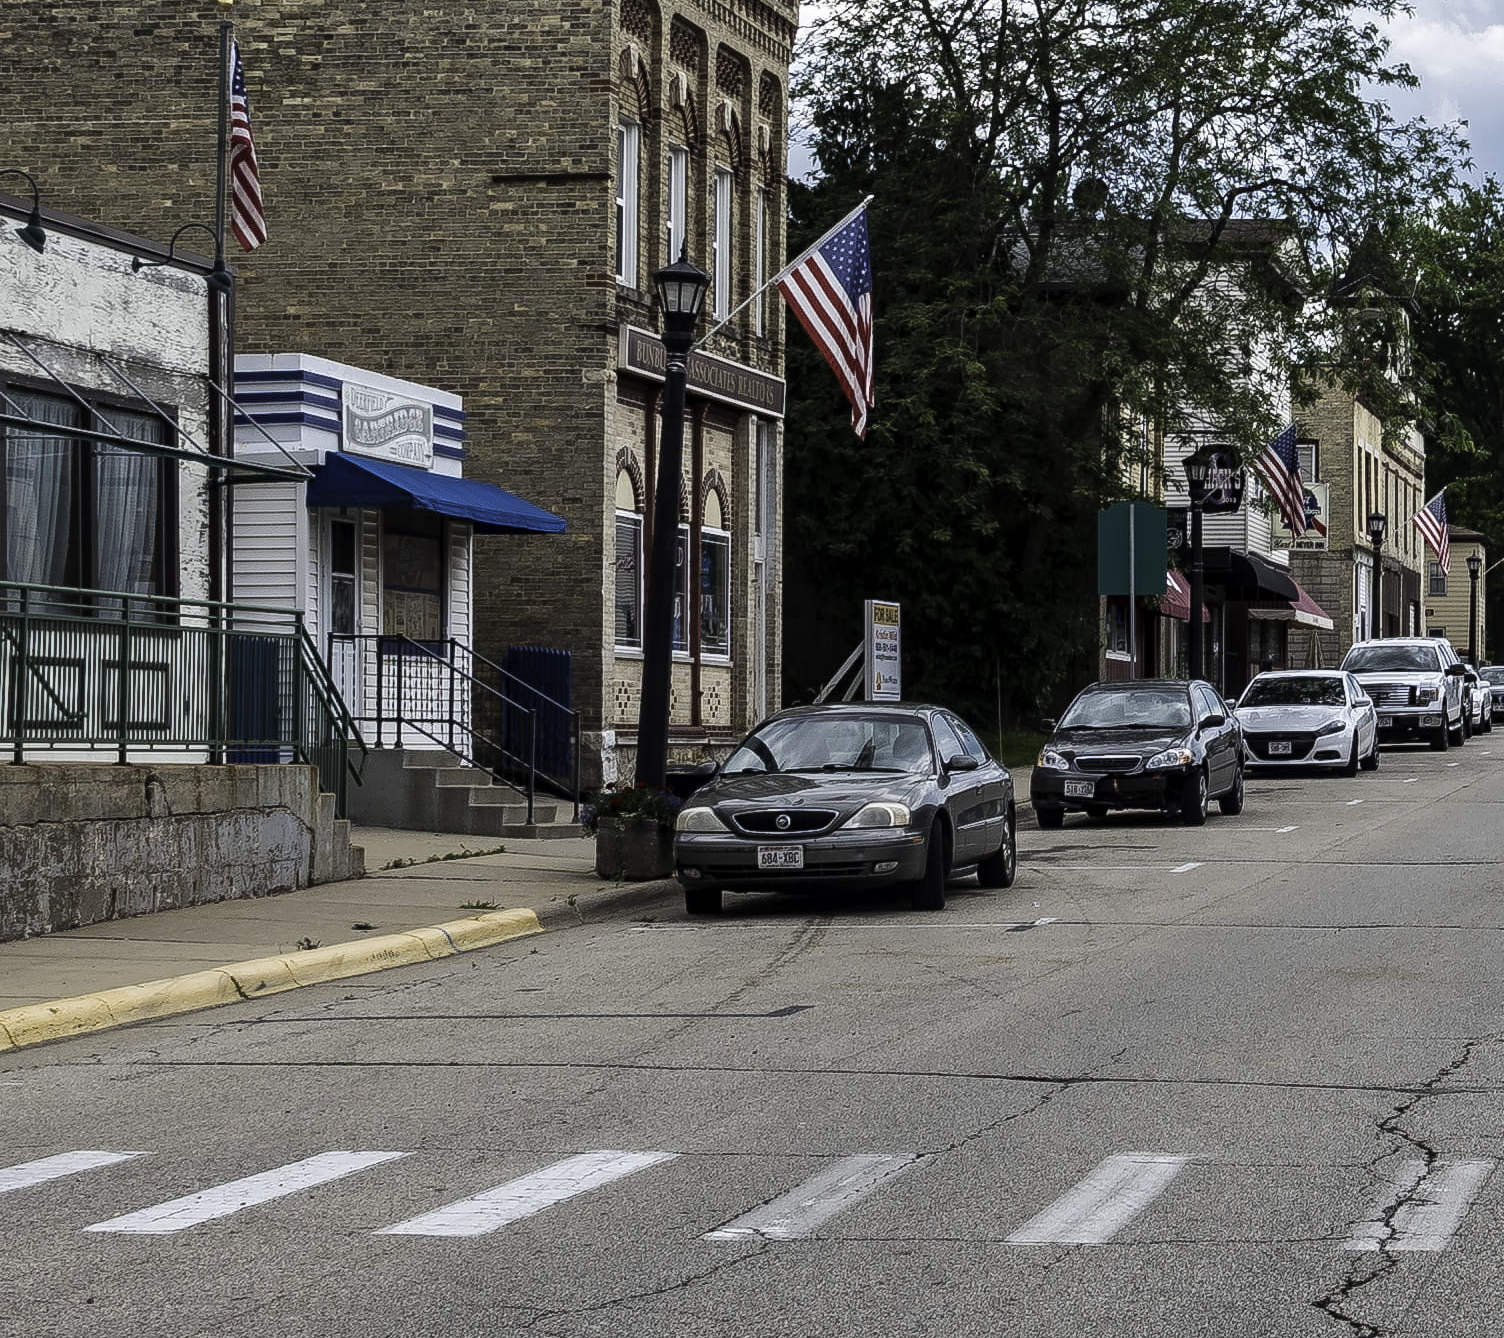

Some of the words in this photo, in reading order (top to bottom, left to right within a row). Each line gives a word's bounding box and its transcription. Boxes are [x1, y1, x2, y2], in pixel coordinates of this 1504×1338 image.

[689, 359, 735, 394] ASSOCIATES
[874, 607, 885, 621] FOR
[886, 607, 899, 623] SALE
